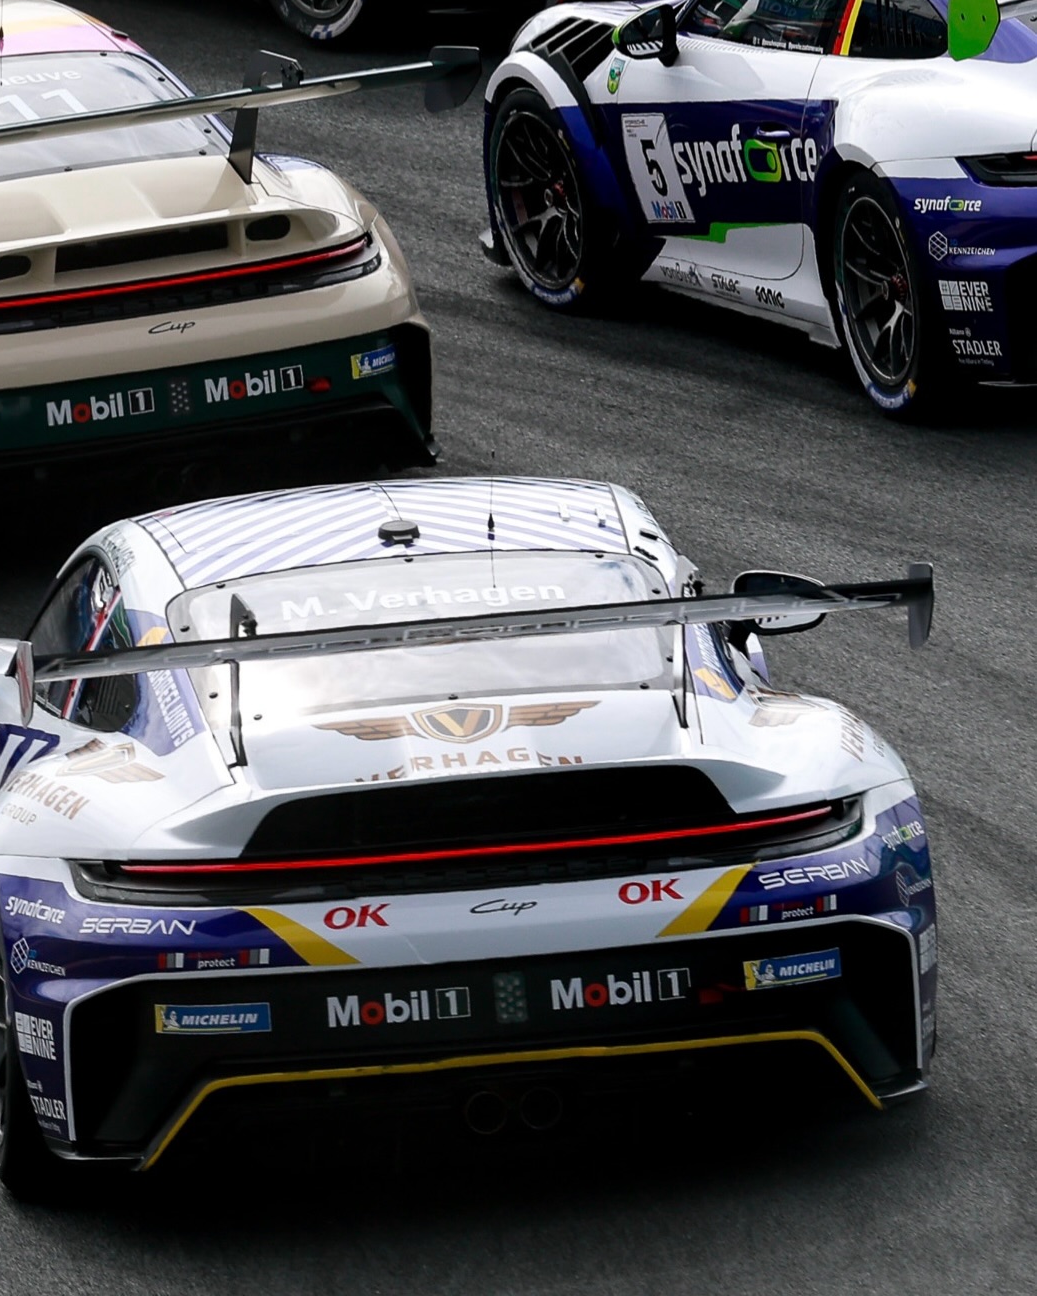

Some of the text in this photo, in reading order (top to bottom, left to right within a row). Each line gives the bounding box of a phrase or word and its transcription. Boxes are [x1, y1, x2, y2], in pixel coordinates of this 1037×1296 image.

[640, 139, 669, 197] 5
[651, 201, 678, 220] Mobil
[913, 195, 982, 214] synaforce
[948, 246, 996, 256] KENNZEICHEN
[958, 280, 990, 296] EVER
[962, 296, 994, 312] NINE
[148, 318, 196, 334] Cup
[951, 339, 1003, 357] STADLER
[204, 369, 277, 403] Mobil
[46, 392, 125, 426] Mobil
[280, 584, 566, 621] M. Verhagen
[757, 857, 870, 891] SERBAN
[618, 877, 685, 906] OK
[323, 902, 392, 930] OK
[470, 898, 539, 916] Cup
[781, 905, 815, 920] protect
[78, 916, 197, 936] SERBAN
[197, 956, 236, 970] protect
[779, 958, 836, 977] MICHELIN
[550, 971, 653, 1011] Mobil
[327, 989, 430, 1028] Mobil
[30, 1015, 55, 1041] EVER
[181, 1011, 259, 1026] MICHELIN
[32, 1034, 58, 1061] NINE
